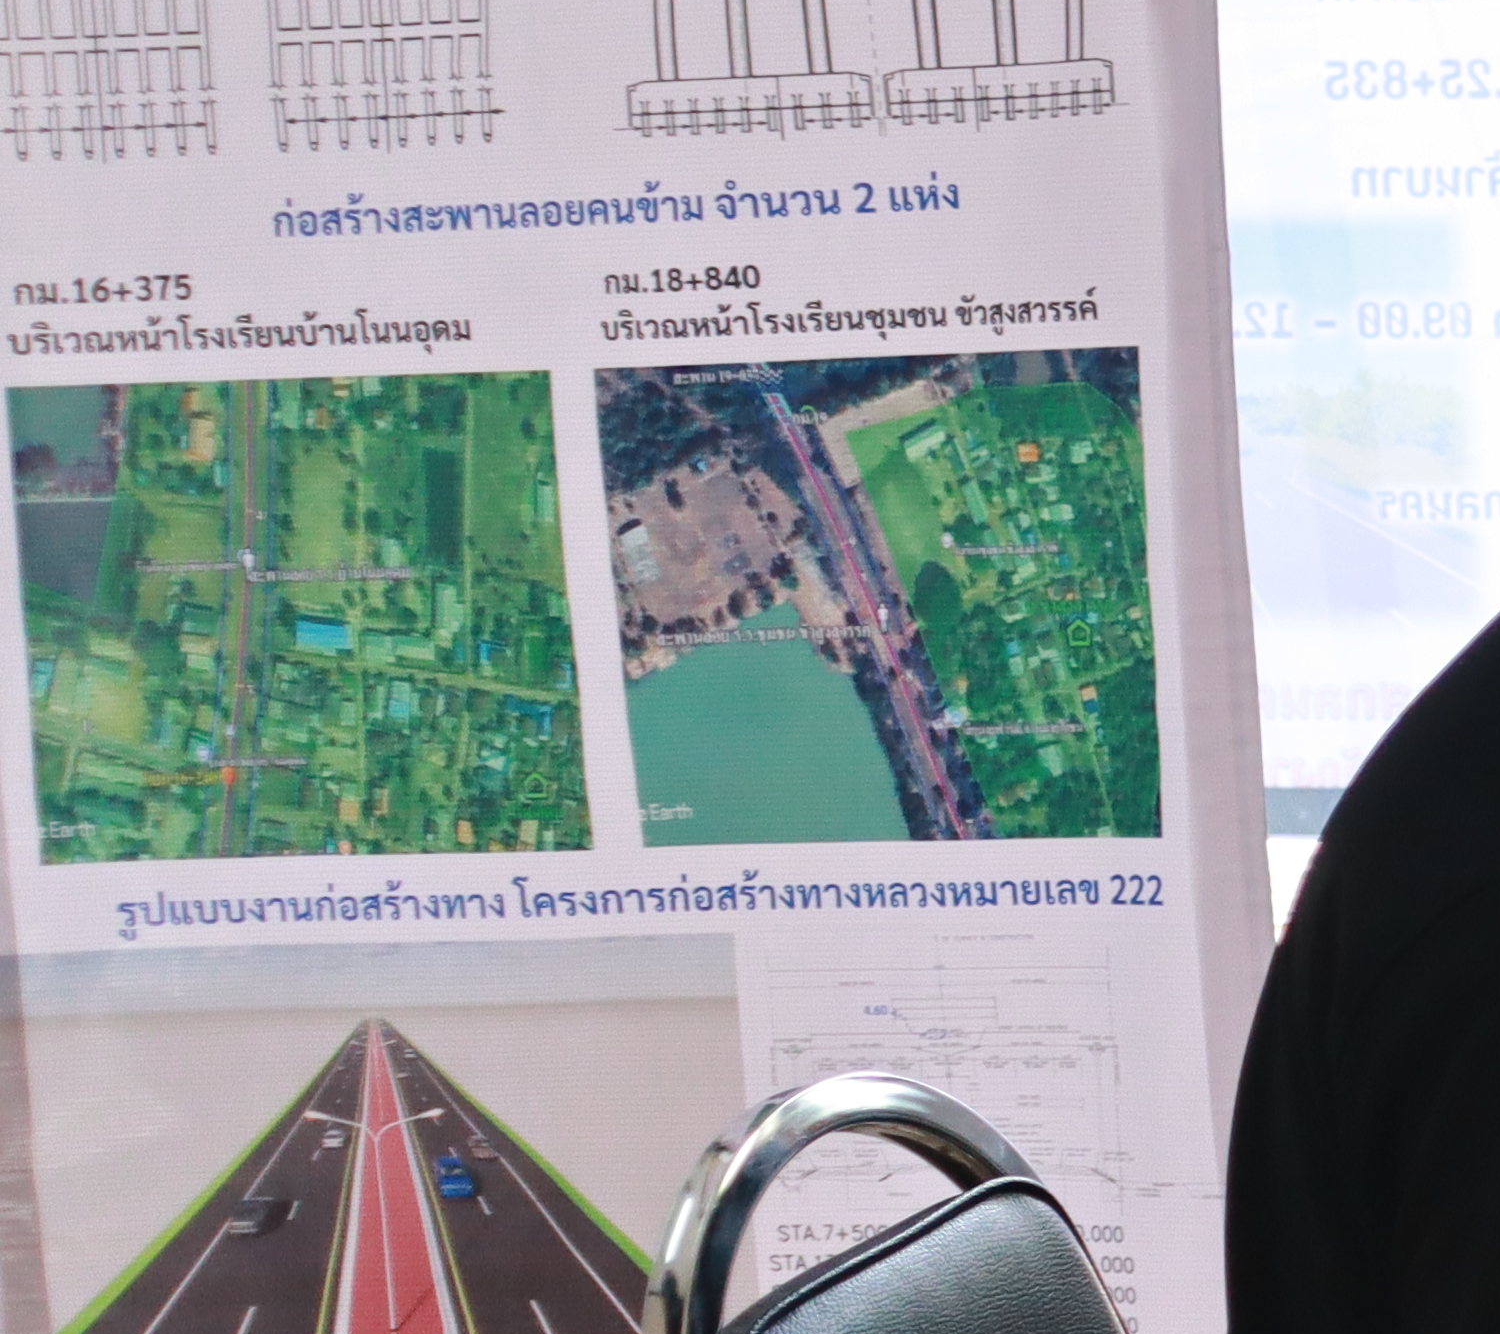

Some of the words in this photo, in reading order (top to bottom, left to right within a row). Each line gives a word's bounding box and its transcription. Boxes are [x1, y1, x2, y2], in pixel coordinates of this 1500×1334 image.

[273, 181, 702, 237] ก่อสร้างสะพานลอยคนข้าม
[715, 181, 839, 220] จำนวน
[854, 183, 877, 213] 2
[889, 171, 960, 212] แห่ง
[13, 274, 192, 305] กม.16+375
[604, 265, 761, 295] กม.18+840
[8, 309, 472, 356] บริเวณหน้าโรงเรียนบ้านโนนอุดม
[601, 300, 947, 342] บริเวณหน้าโรงเรียนชุมชน
[955, 286, 1099, 336] ขัวสูงสวรรค์
[648, 803, 694, 821] Earth
[117, 881, 503, 940] รูปแบบงานก่อสร้างทาง
[514, 869, 1100, 918] โครงการก่อสร้างทางหลวงหมายเลข
[1110, 874, 1164, 905] 222
